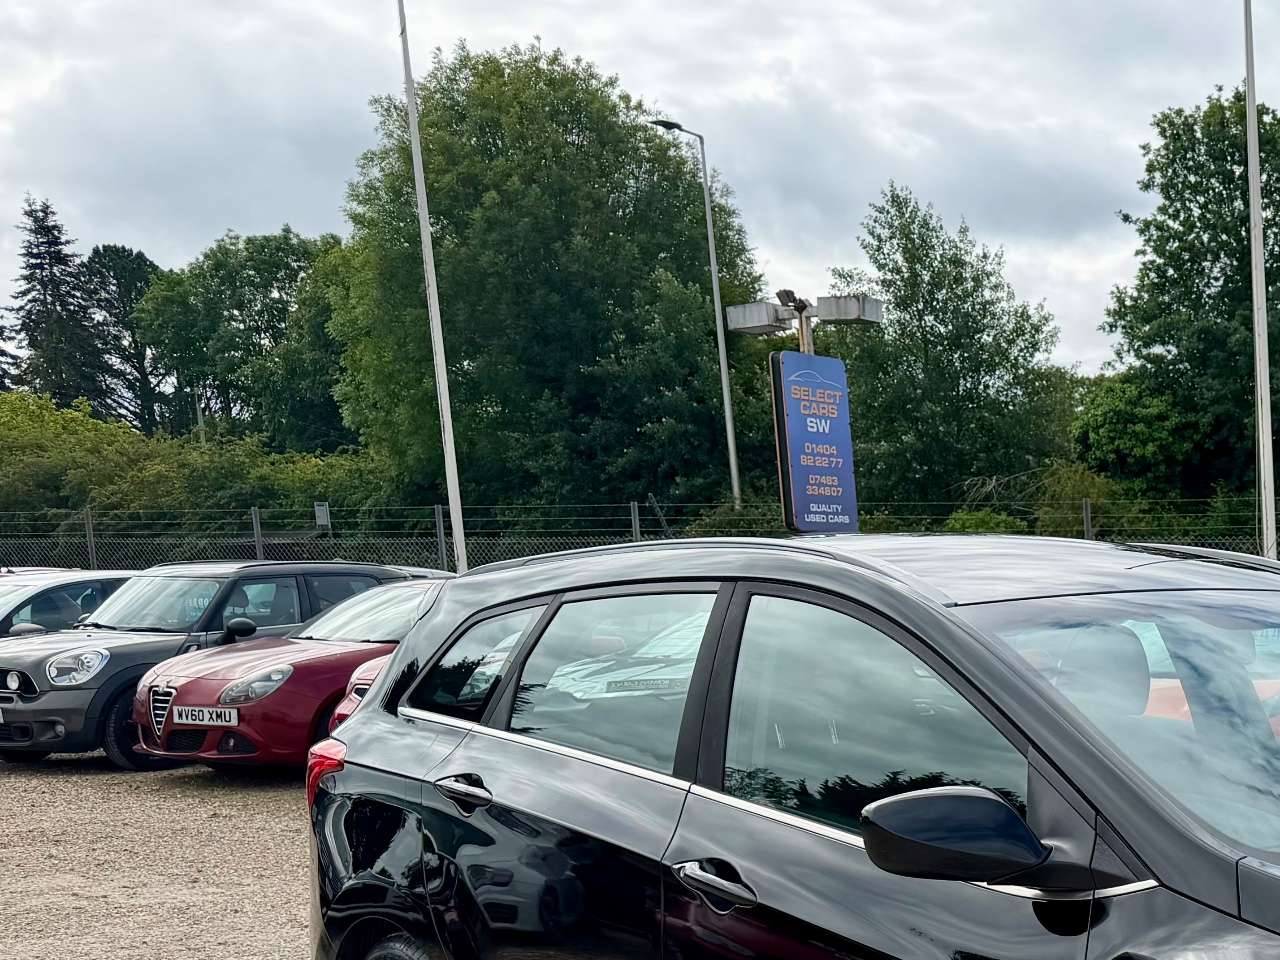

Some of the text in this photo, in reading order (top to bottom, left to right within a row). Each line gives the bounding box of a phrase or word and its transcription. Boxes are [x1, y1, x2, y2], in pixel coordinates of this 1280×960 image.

[791, 385, 842, 404] SELECT
[800, 401, 838, 417] CARS
[806, 418, 830, 433] SW
[804, 442, 837, 456] 01404
[810, 503, 842, 513] QUALITY
[805, 513, 850, 525] USED CARS
[177, 708, 232, 723] WV60 XMU
